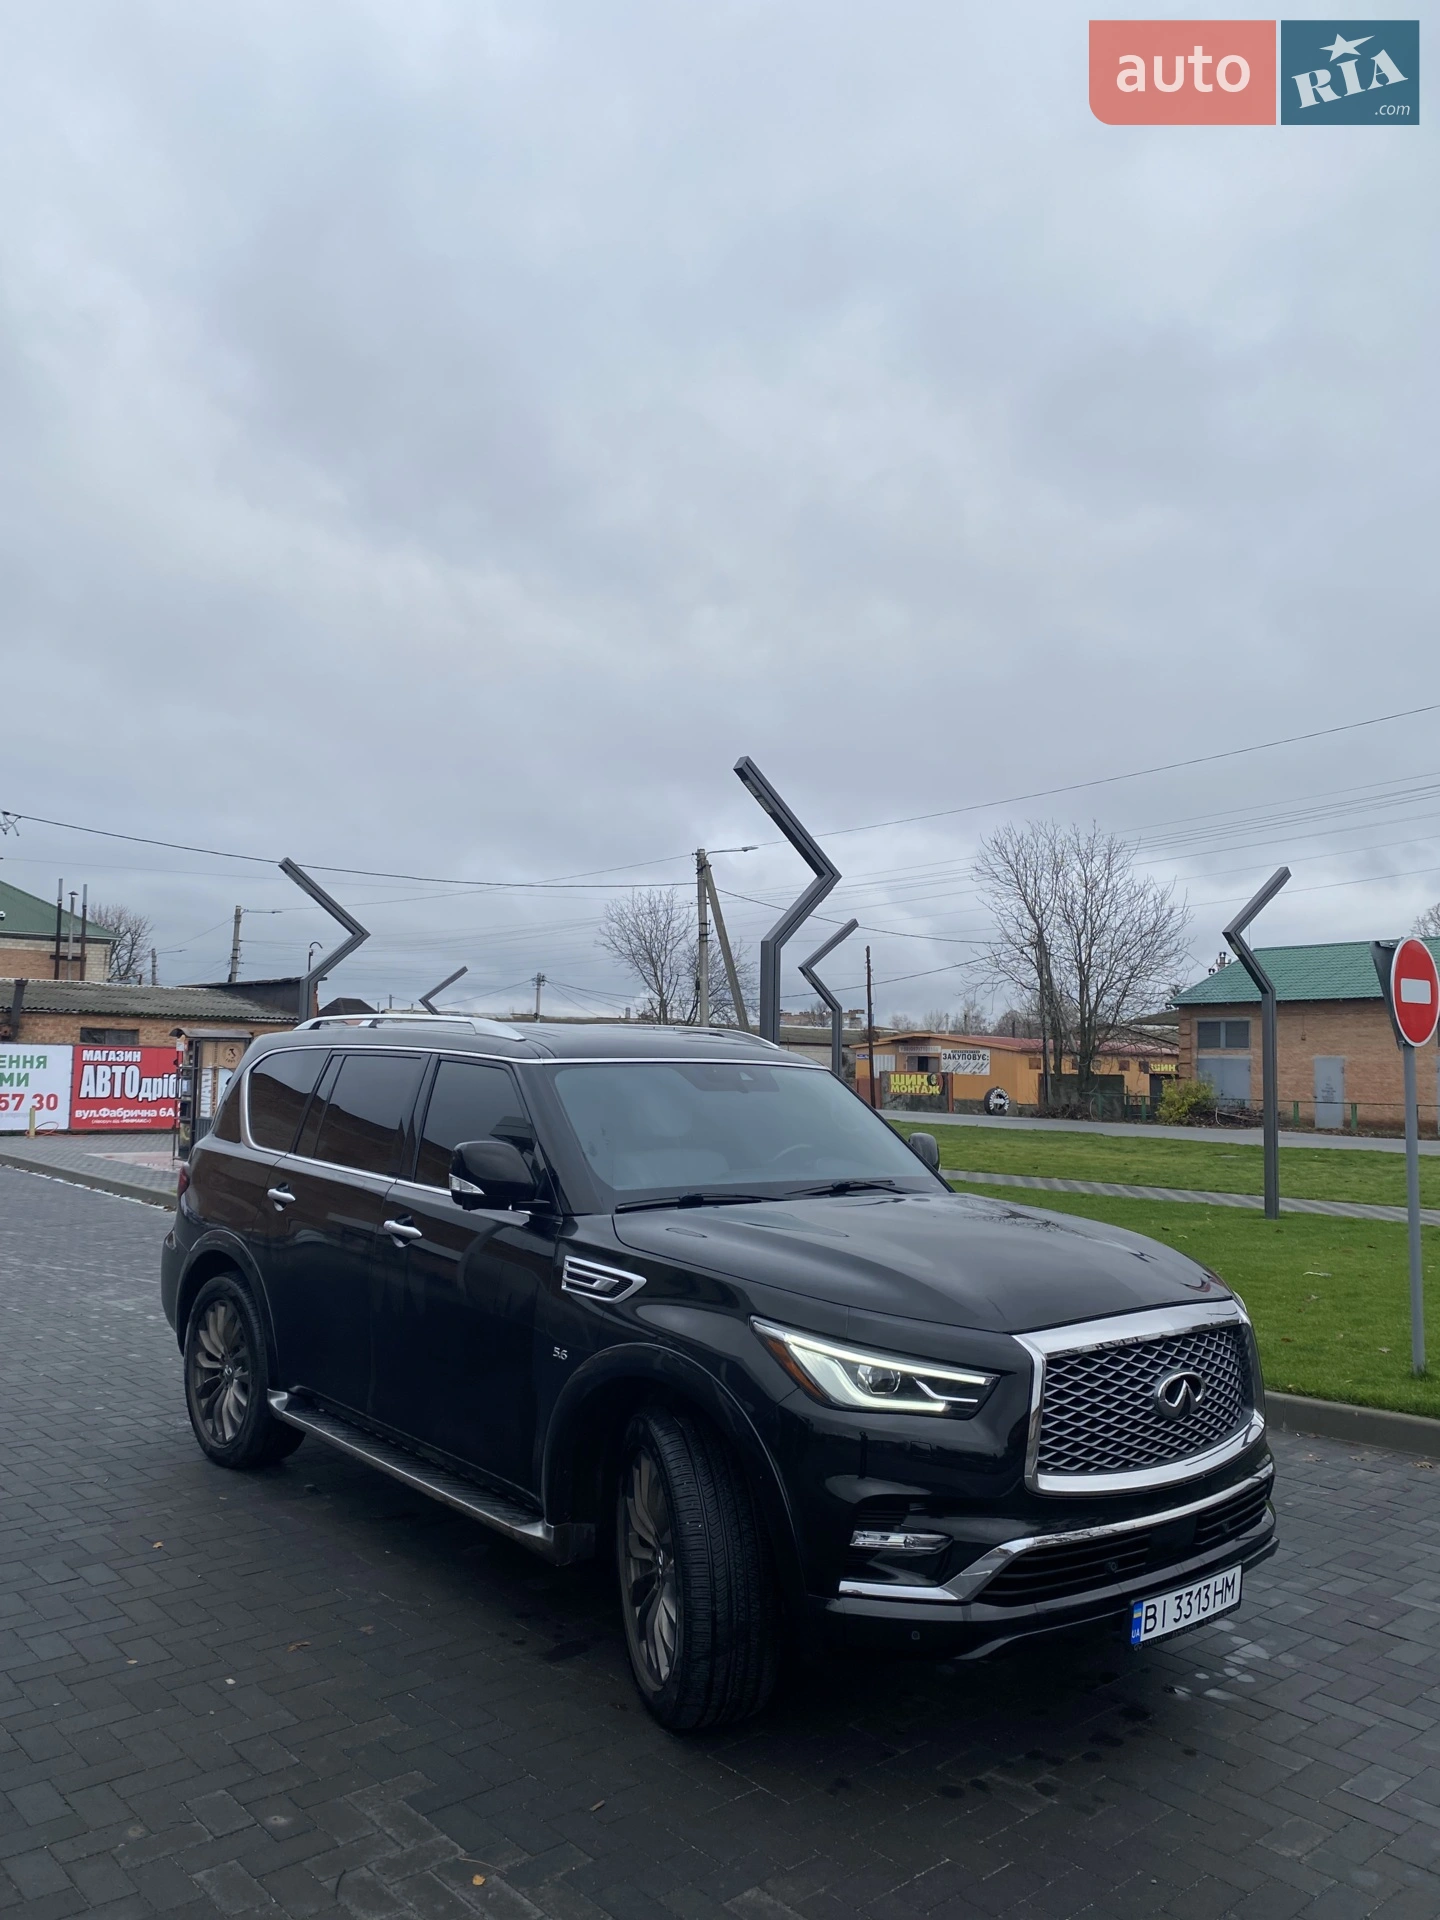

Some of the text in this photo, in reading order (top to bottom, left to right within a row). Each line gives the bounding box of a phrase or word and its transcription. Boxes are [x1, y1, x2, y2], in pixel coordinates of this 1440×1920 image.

[82, 1050, 141, 1062] МАГАЗИН
[942, 1053, 990, 1061] ЗАКУПОВУЄ:
[890, 1085, 940, 1095] МОНТАЖ
[32, 1093, 58, 1111] 30
[1131, 1628, 1140, 1639] UA
